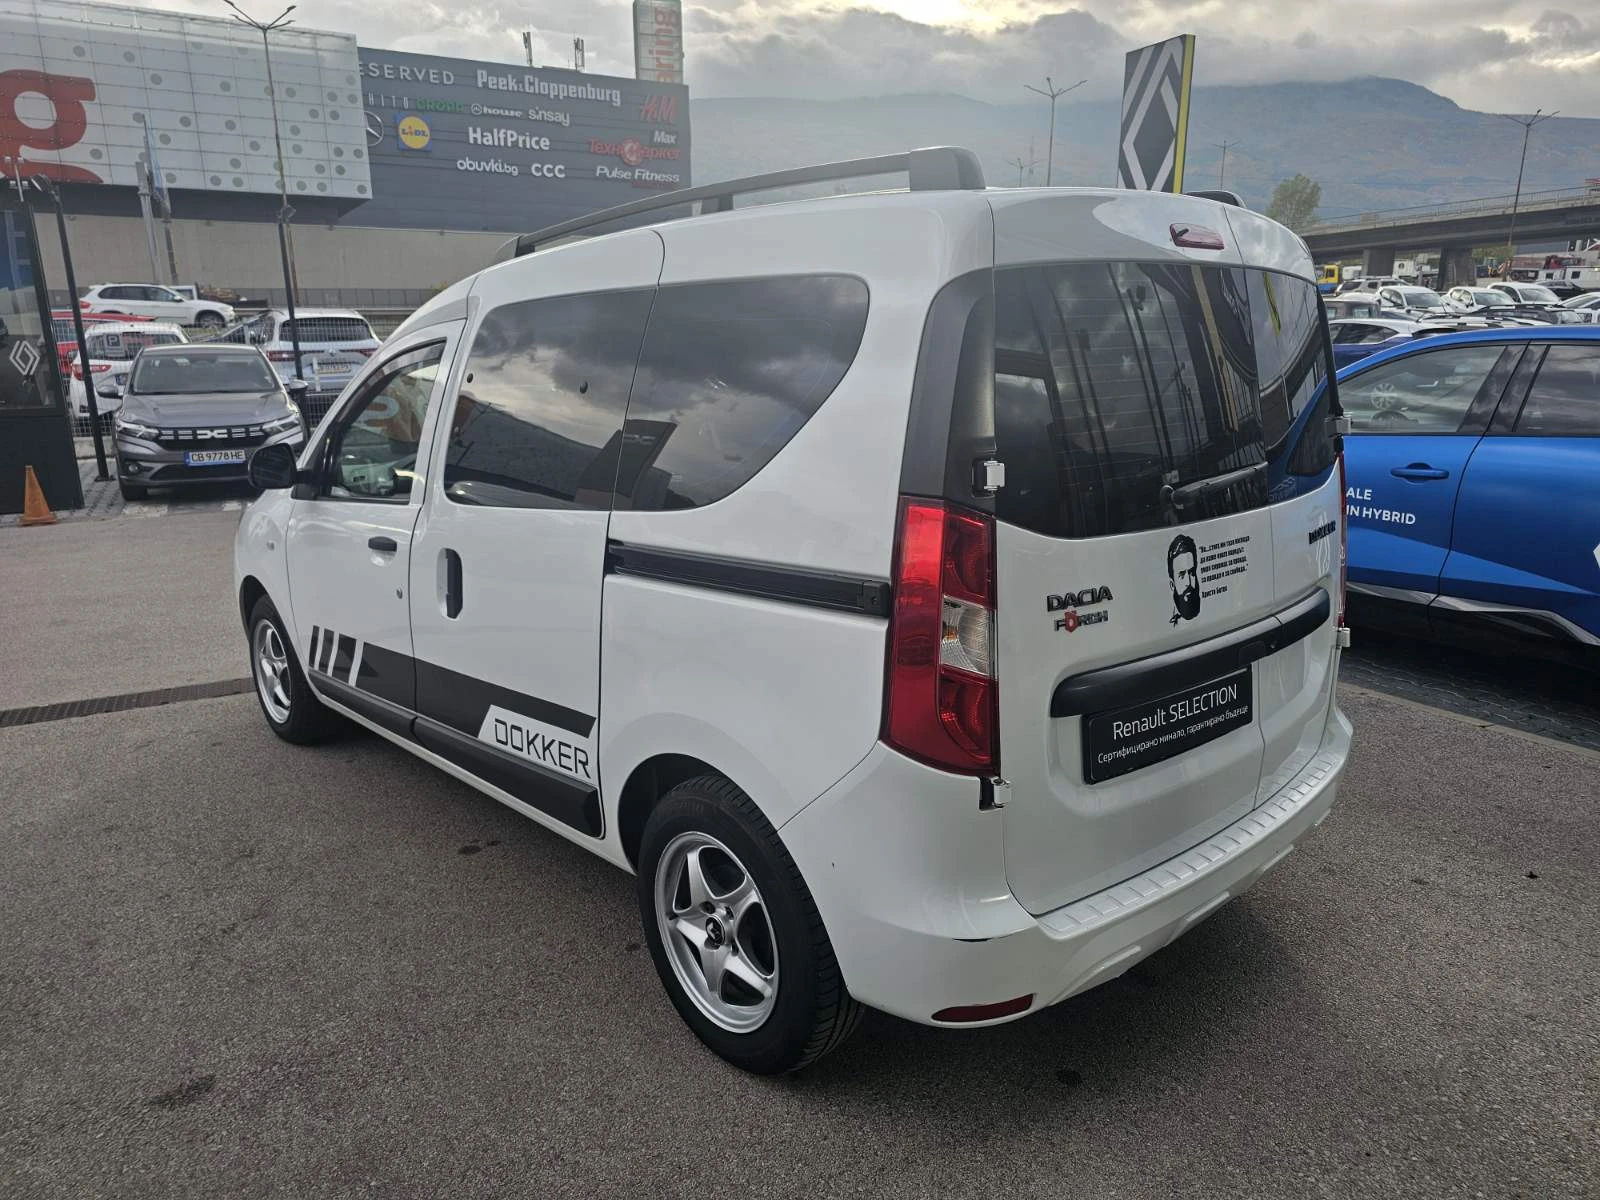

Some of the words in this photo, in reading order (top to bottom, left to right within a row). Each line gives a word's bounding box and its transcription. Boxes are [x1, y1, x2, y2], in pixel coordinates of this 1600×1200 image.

[468, 127, 550, 150] HalfPrice
[653, 130, 677, 144] Max
[457, 157, 519, 176] obuvki.bg
[531, 163, 566, 178] CCC
[596, 165, 632, 180] Pulse
[634, 168, 680, 182] Fitness
[1346, 486, 1373, 501] ALE
[1362, 506, 1416, 525] HYBRID
[1047, 585, 1114, 612] DACIA
[1113, 708, 1167, 741] Renault
[1169, 683, 1237, 723] SELECTION
[1097, 737, 1159, 764] Сертифицирано
[1159, 728, 1187, 744] минало,
[1186, 714, 1226, 735] гарантирано
[1225, 705, 1249, 720] бъдеще
[494, 717, 591, 780] DOKKER
